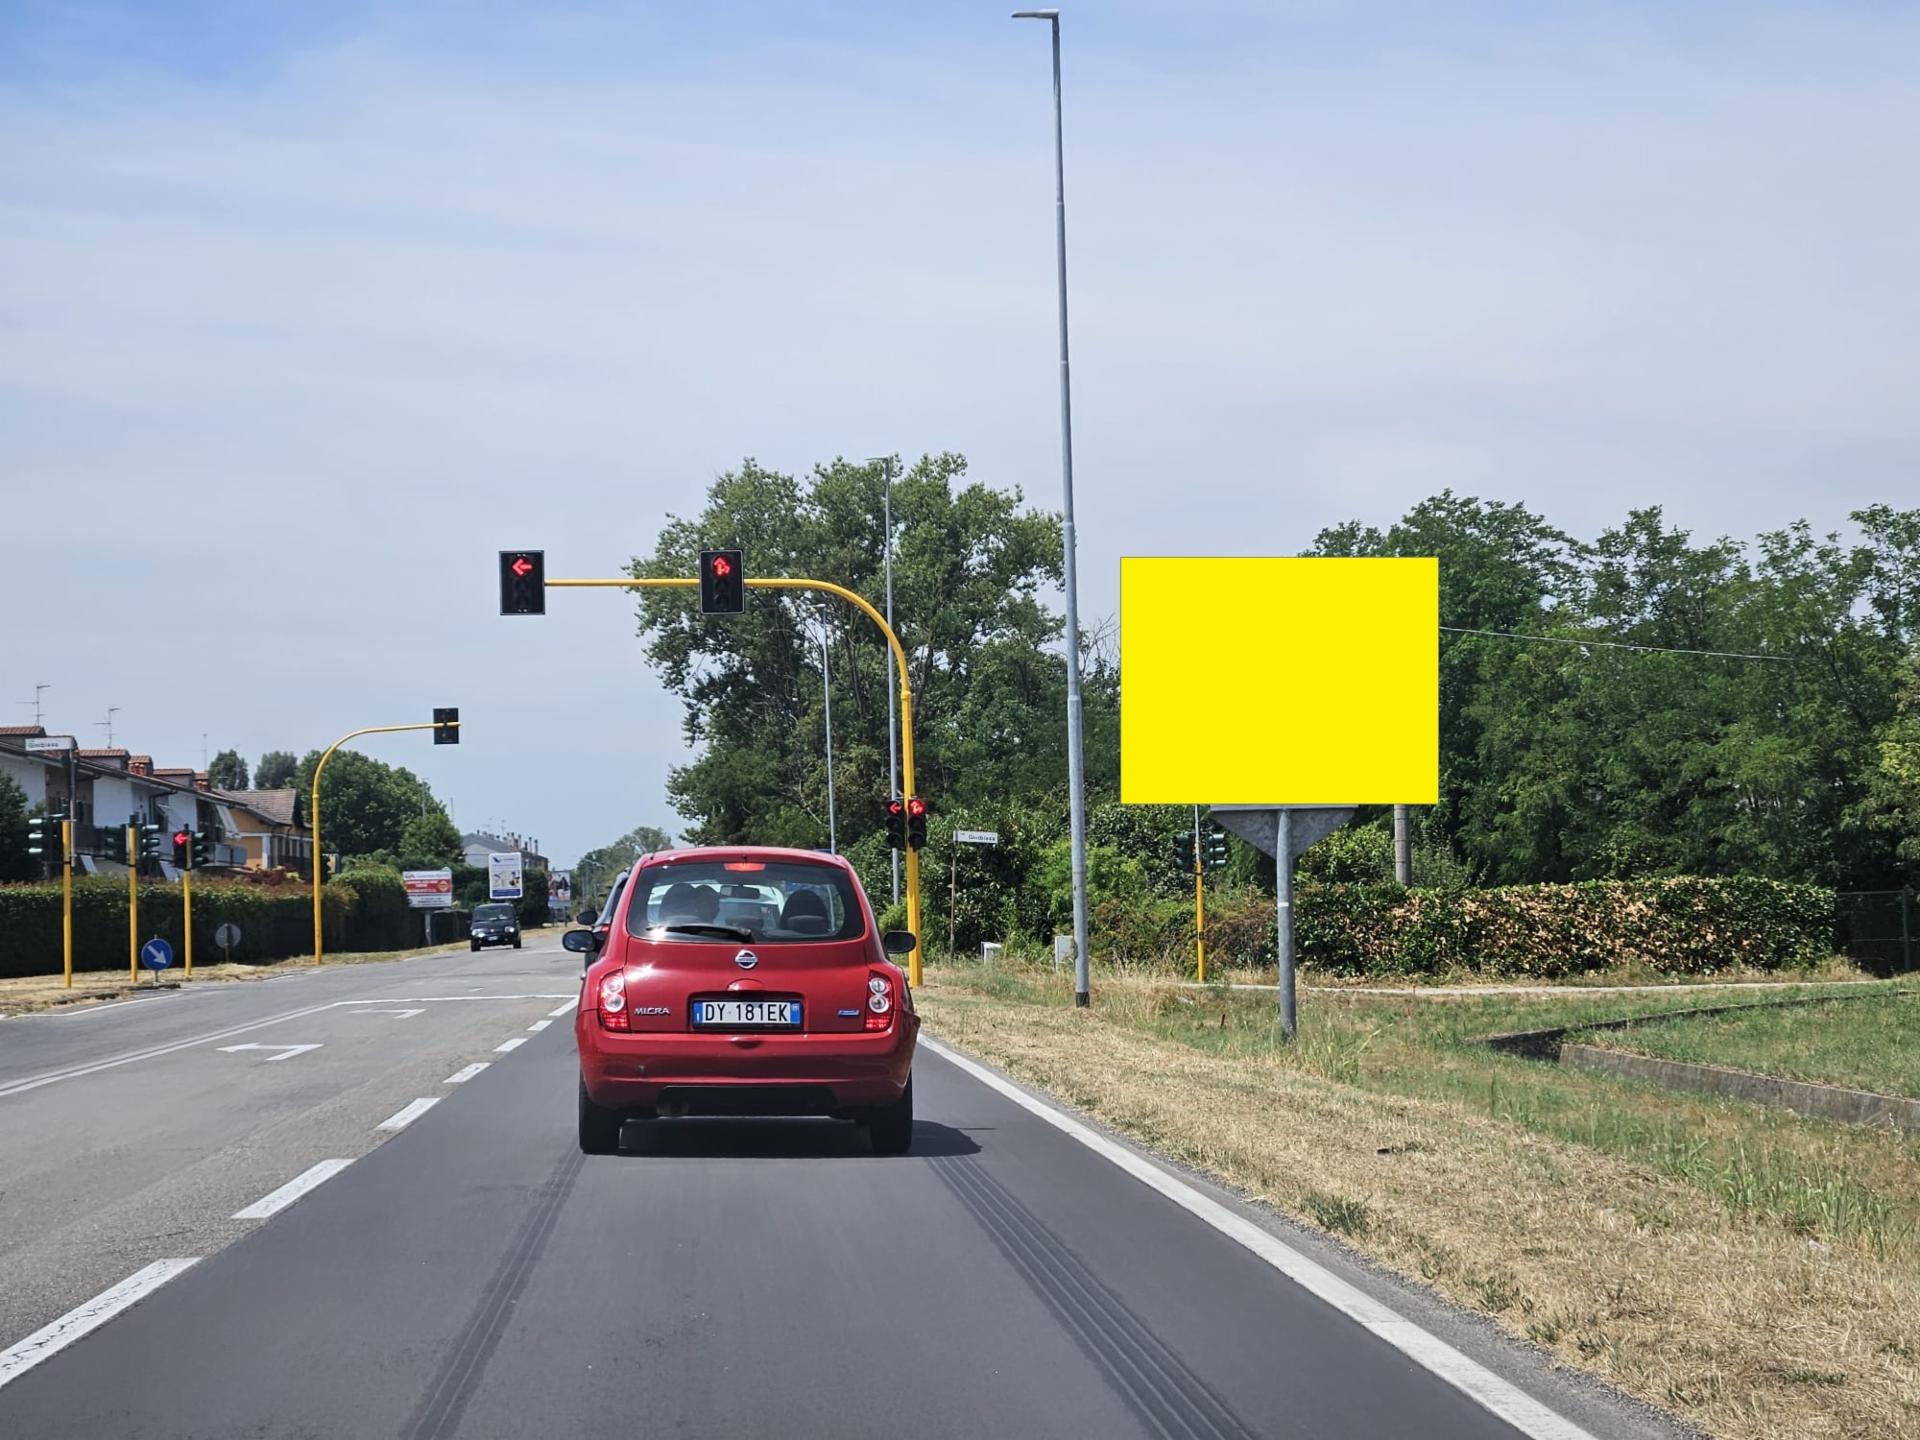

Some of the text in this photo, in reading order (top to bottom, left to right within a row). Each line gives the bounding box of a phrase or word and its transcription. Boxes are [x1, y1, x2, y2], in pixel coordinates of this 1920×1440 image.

[633, 1007, 670, 1015] MICRA
[705, 1003, 788, 1021] DY 181EK
